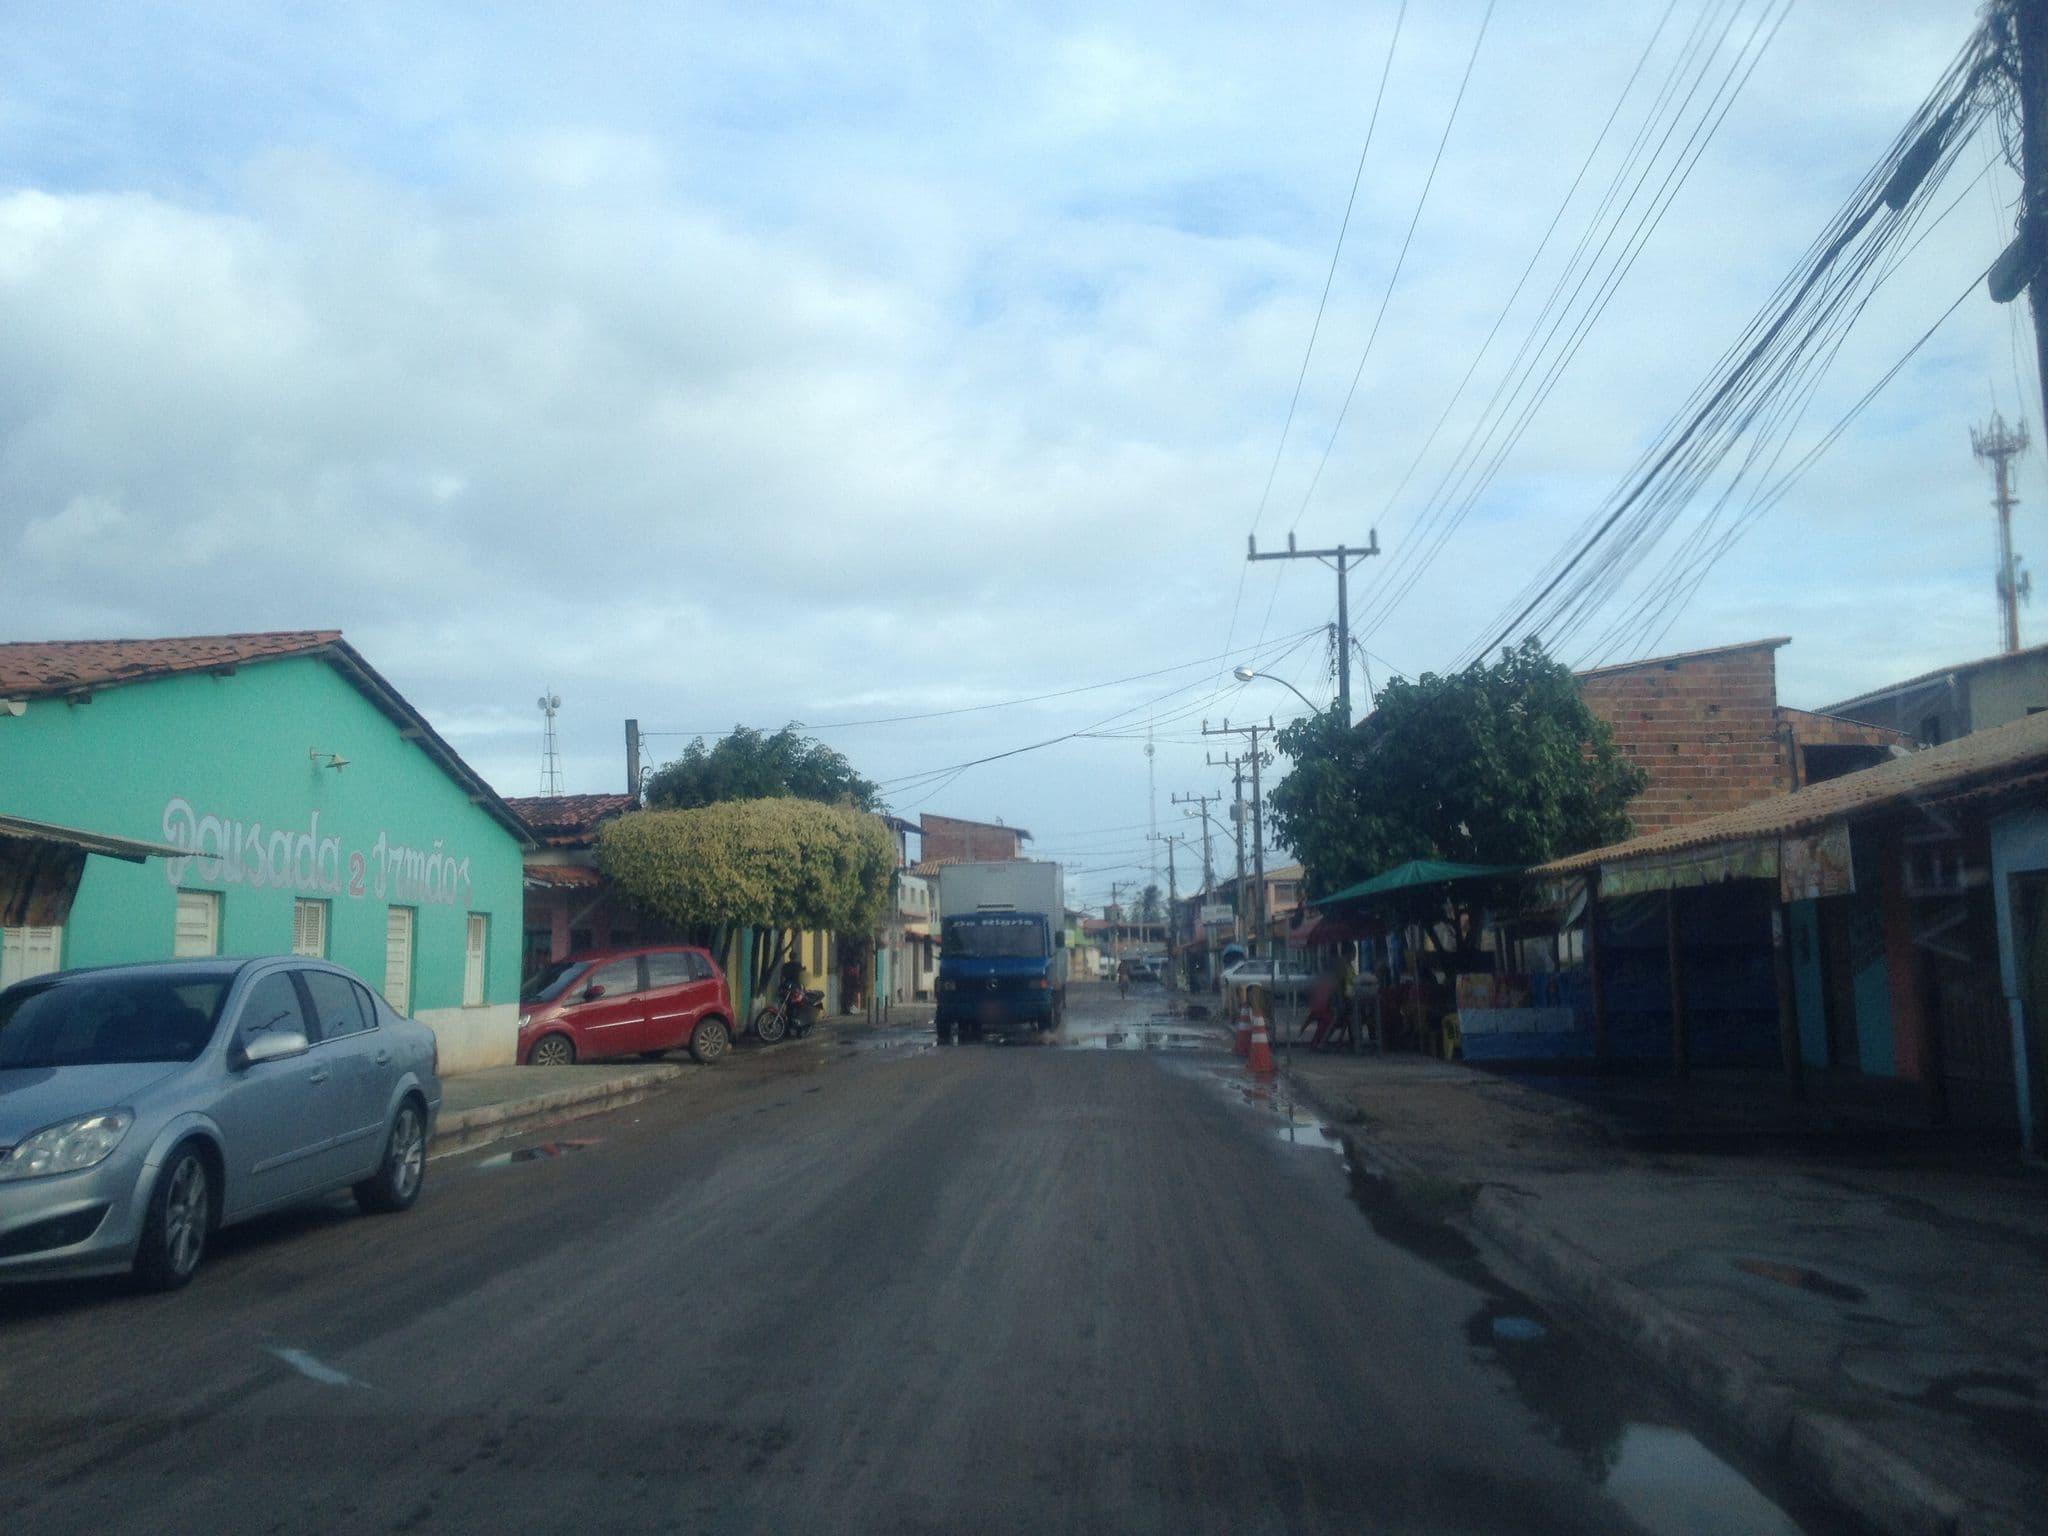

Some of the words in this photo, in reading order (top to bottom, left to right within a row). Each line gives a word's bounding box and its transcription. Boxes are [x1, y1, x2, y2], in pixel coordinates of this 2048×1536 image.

[163, 797, 341, 893] Pousada
[349, 852, 366, 896] 2
[372, 830, 473, 906] Irmãos
